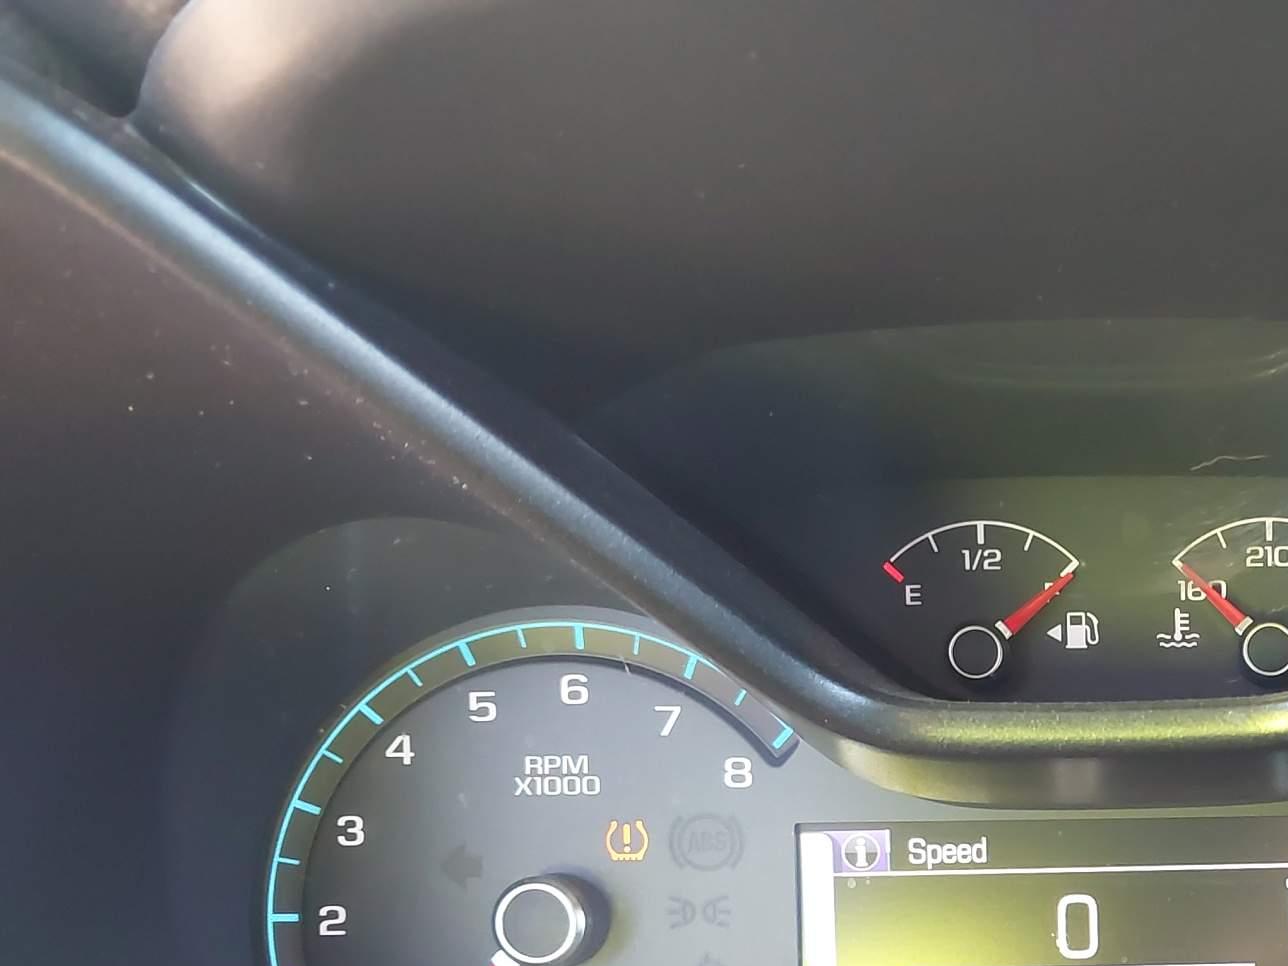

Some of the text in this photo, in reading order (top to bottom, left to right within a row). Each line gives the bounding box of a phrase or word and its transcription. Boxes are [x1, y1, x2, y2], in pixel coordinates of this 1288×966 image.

[961, 549, 1002, 571] 1/2
[905, 584, 922, 606] E
[1177, 579, 1227, 601] 160
[560, 674, 589, 705] 6
[468, 691, 497, 722] 5
[654, 705, 681, 737] 7
[385, 734, 416, 765] 4
[524, 755, 590, 777] RPM
[723, 757, 753, 788] 8
[514, 775, 601, 796] X1000
[337, 815, 365, 846] 3
[907, 836, 988, 870] Speed
[319, 905, 347, 936] 2
[1055, 894, 1099, 960] 0
